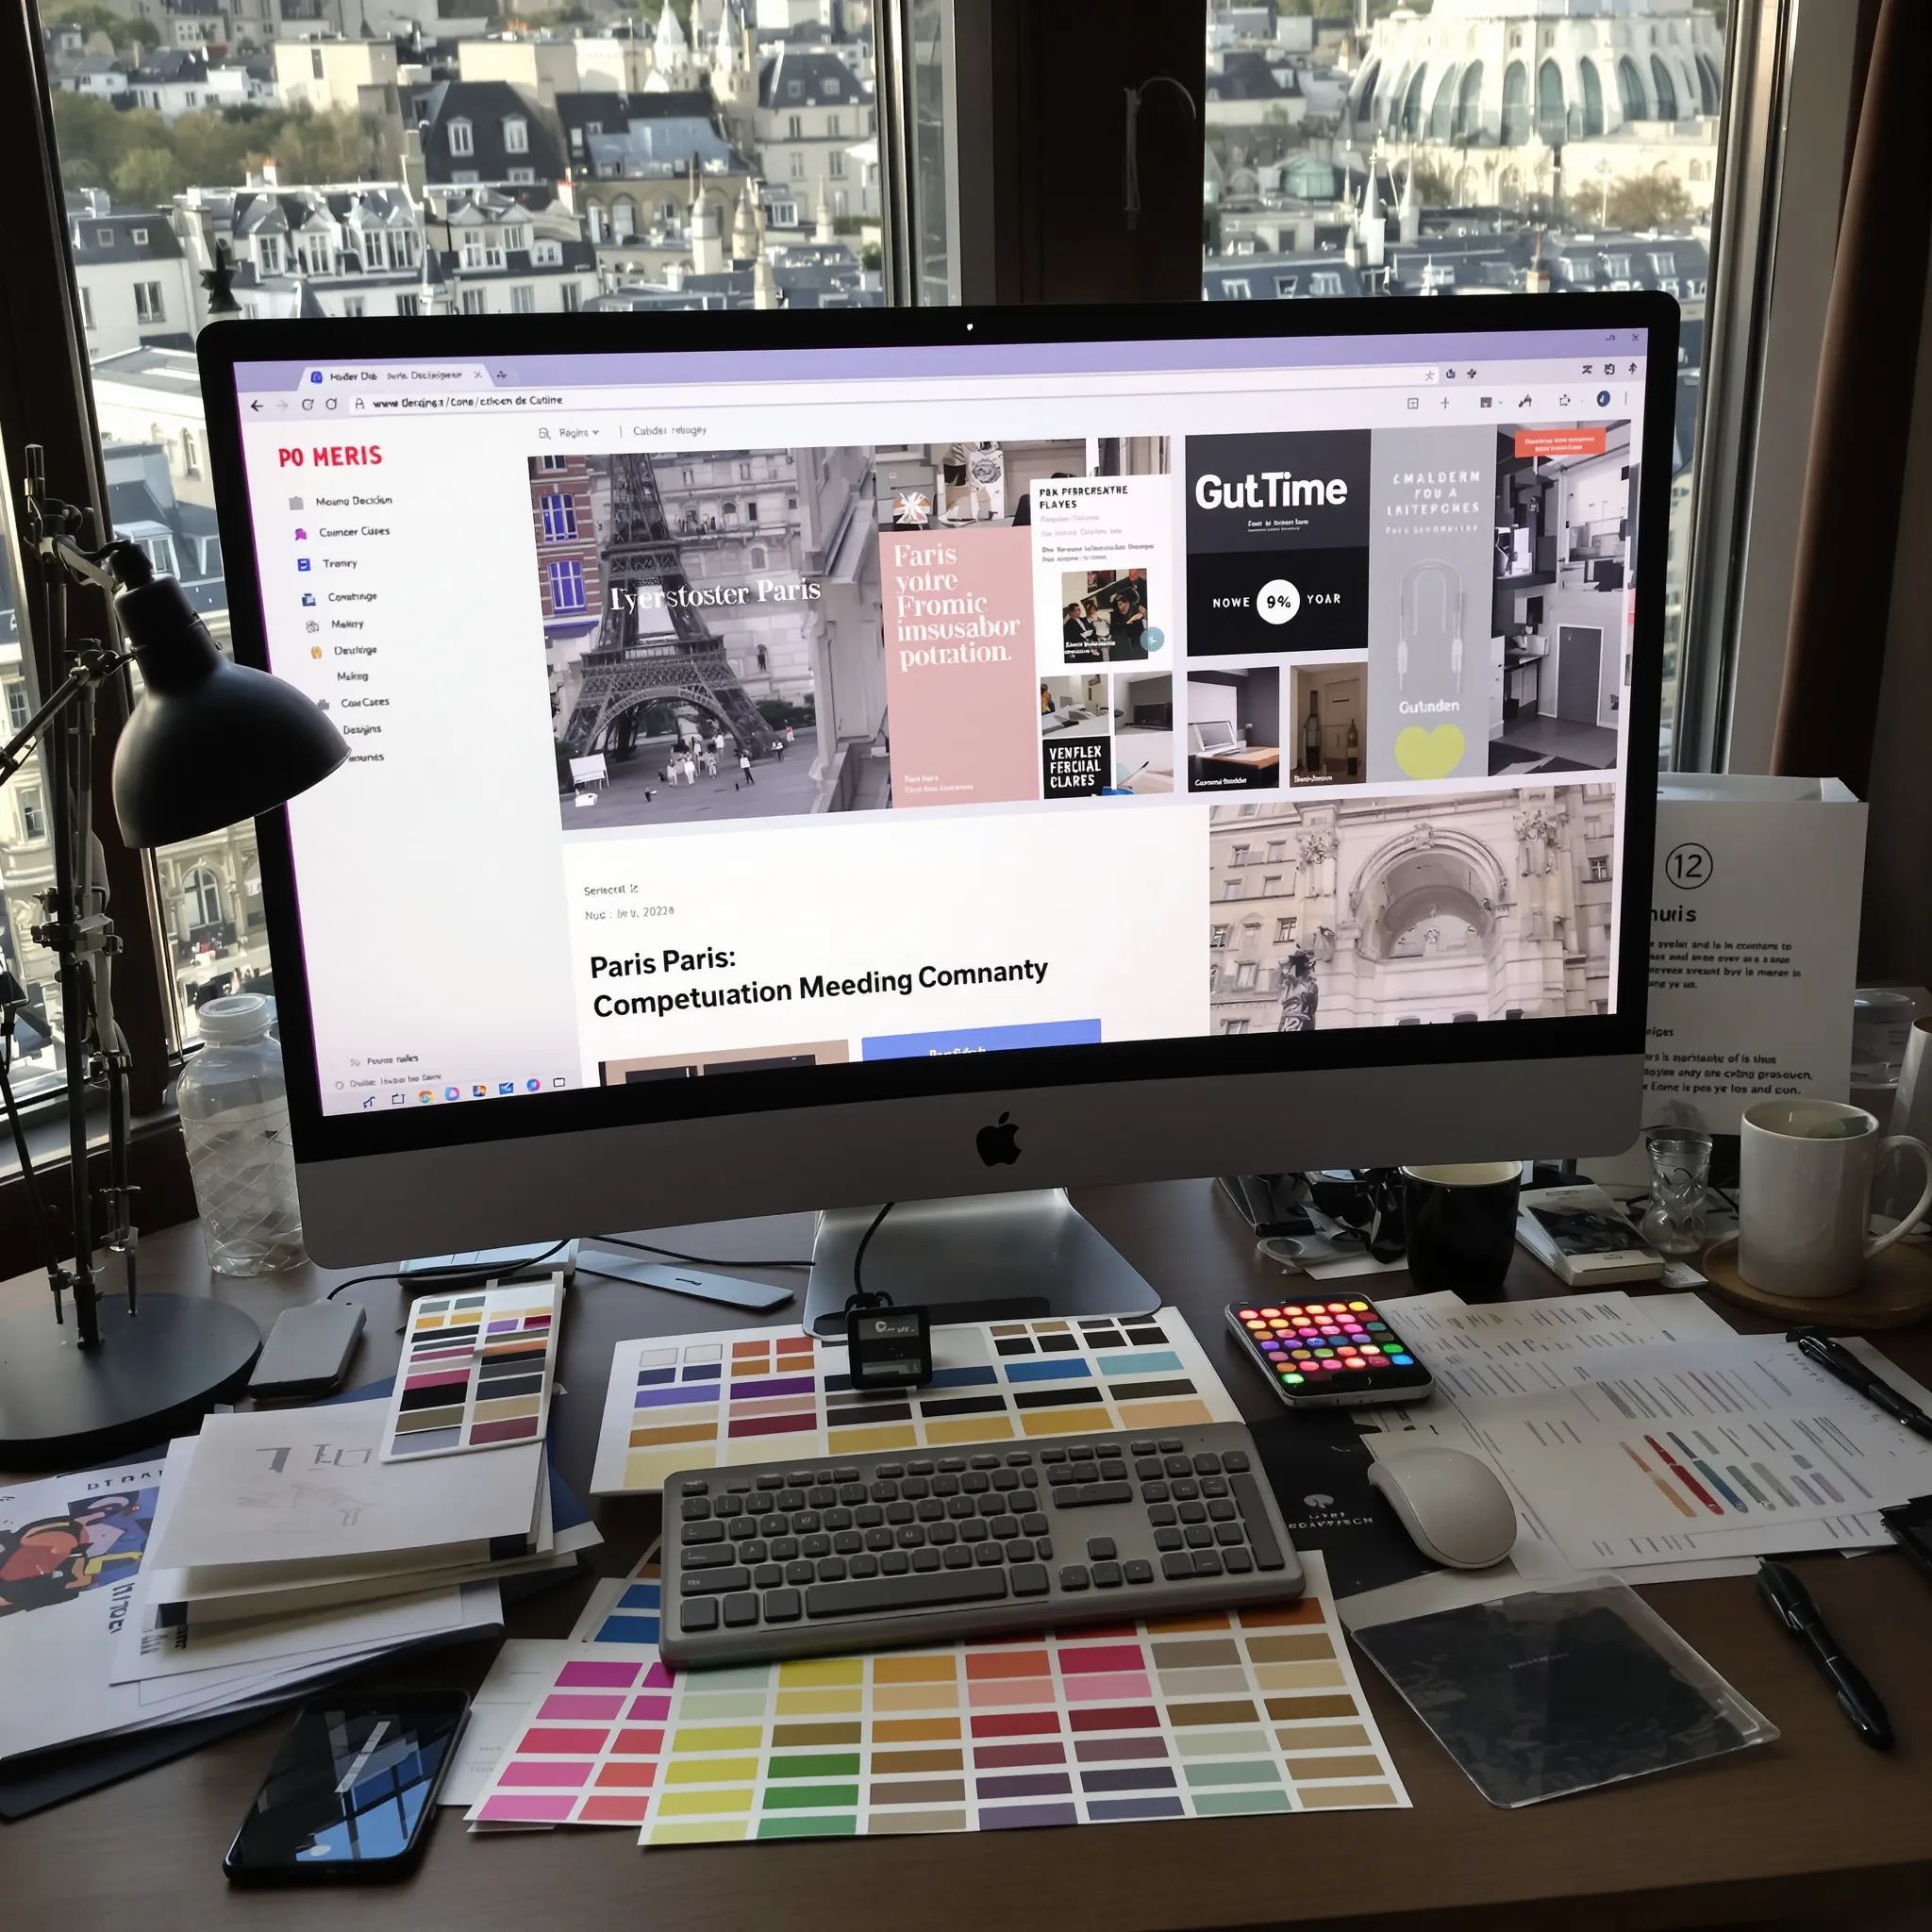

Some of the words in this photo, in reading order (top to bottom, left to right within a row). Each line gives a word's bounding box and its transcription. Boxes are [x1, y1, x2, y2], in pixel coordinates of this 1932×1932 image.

[278, 448, 305, 468] PO
[312, 445, 383, 467] MERIS
[757, 577, 822, 602] Paris
[1212, 597, 1250, 608] NOWE
[1266, 594, 1291, 609] 9%
[896, 592, 988, 618] Fromic
[1674, 853, 1703, 879] 12
[591, 951, 657, 979] Paris
[662, 946, 737, 973] Paris:
[799, 970, 913, 998] Meeding
[918, 957, 1049, 989] Comnanty
[1727, 1053, 1740, 1064] of
[1750, 1083, 1773, 1095] and
